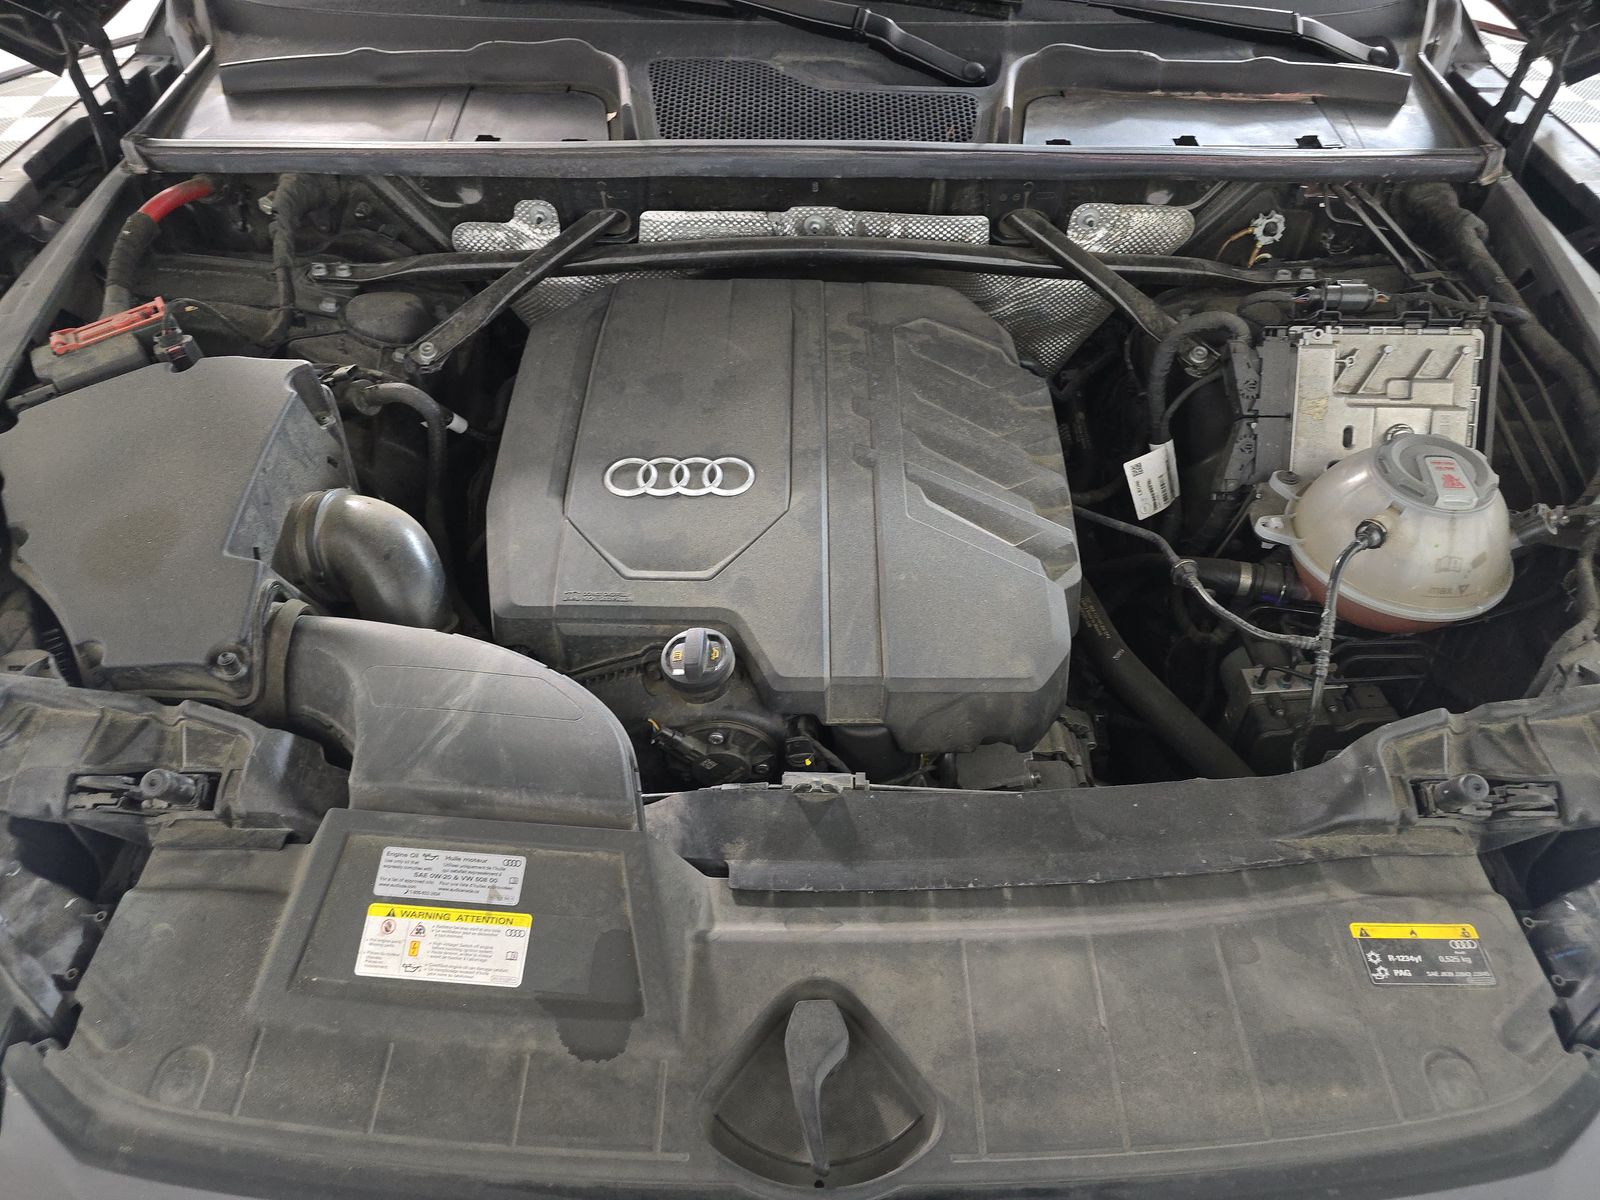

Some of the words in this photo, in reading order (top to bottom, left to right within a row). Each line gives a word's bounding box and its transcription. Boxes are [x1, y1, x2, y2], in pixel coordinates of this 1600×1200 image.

[400, 910, 451, 921] WARNING
[456, 914, 514, 925] ATTENTION
[1387, 954, 1422, 963] R-1234yf
[1460, 956, 1472, 964] kg
[1392, 969, 1412, 977] PAG
